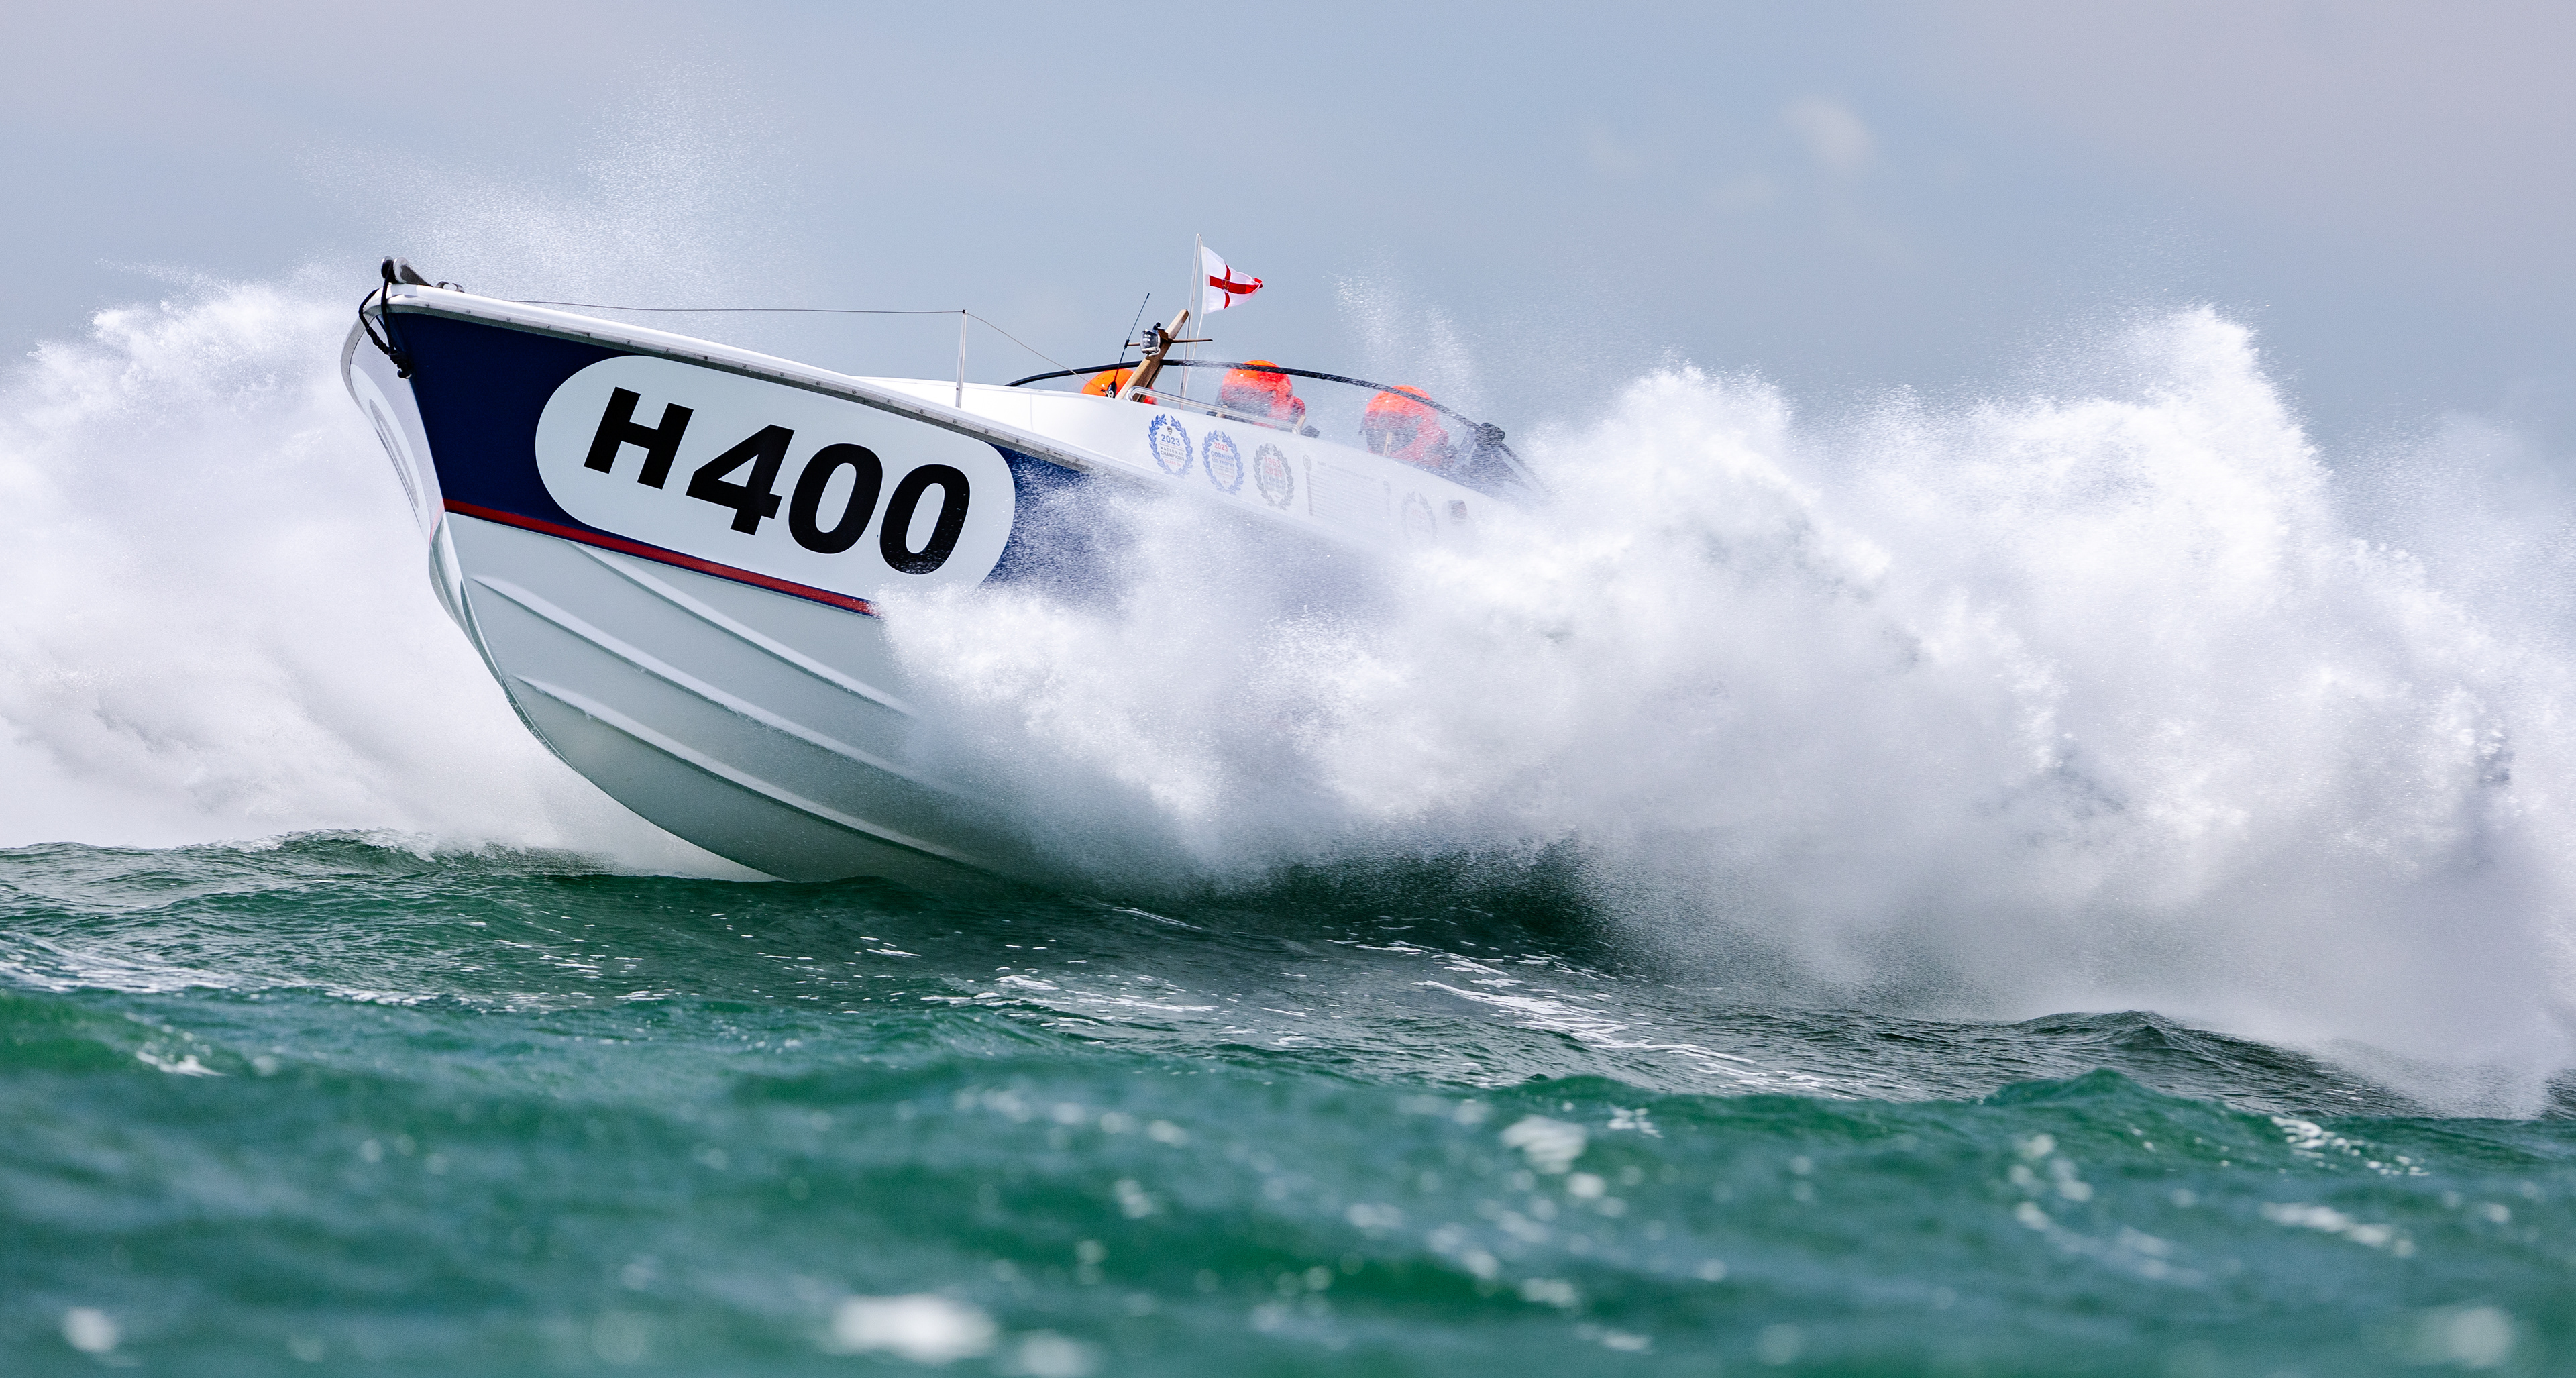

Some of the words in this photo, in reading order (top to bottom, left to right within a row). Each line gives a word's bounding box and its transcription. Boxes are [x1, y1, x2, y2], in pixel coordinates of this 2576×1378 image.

[1161, 433, 1181, 446] 2023
[1160, 446, 1184, 456] NATIONAL
[1214, 442, 1228, 452] 2023
[1160, 450, 1185, 461] CHAMPIONS
[1211, 450, 1234, 462] CORNISH
[1264, 456, 1281, 468] 1963
[1265, 466, 1282, 477] 2023
[583, 386, 970, 574] H400
